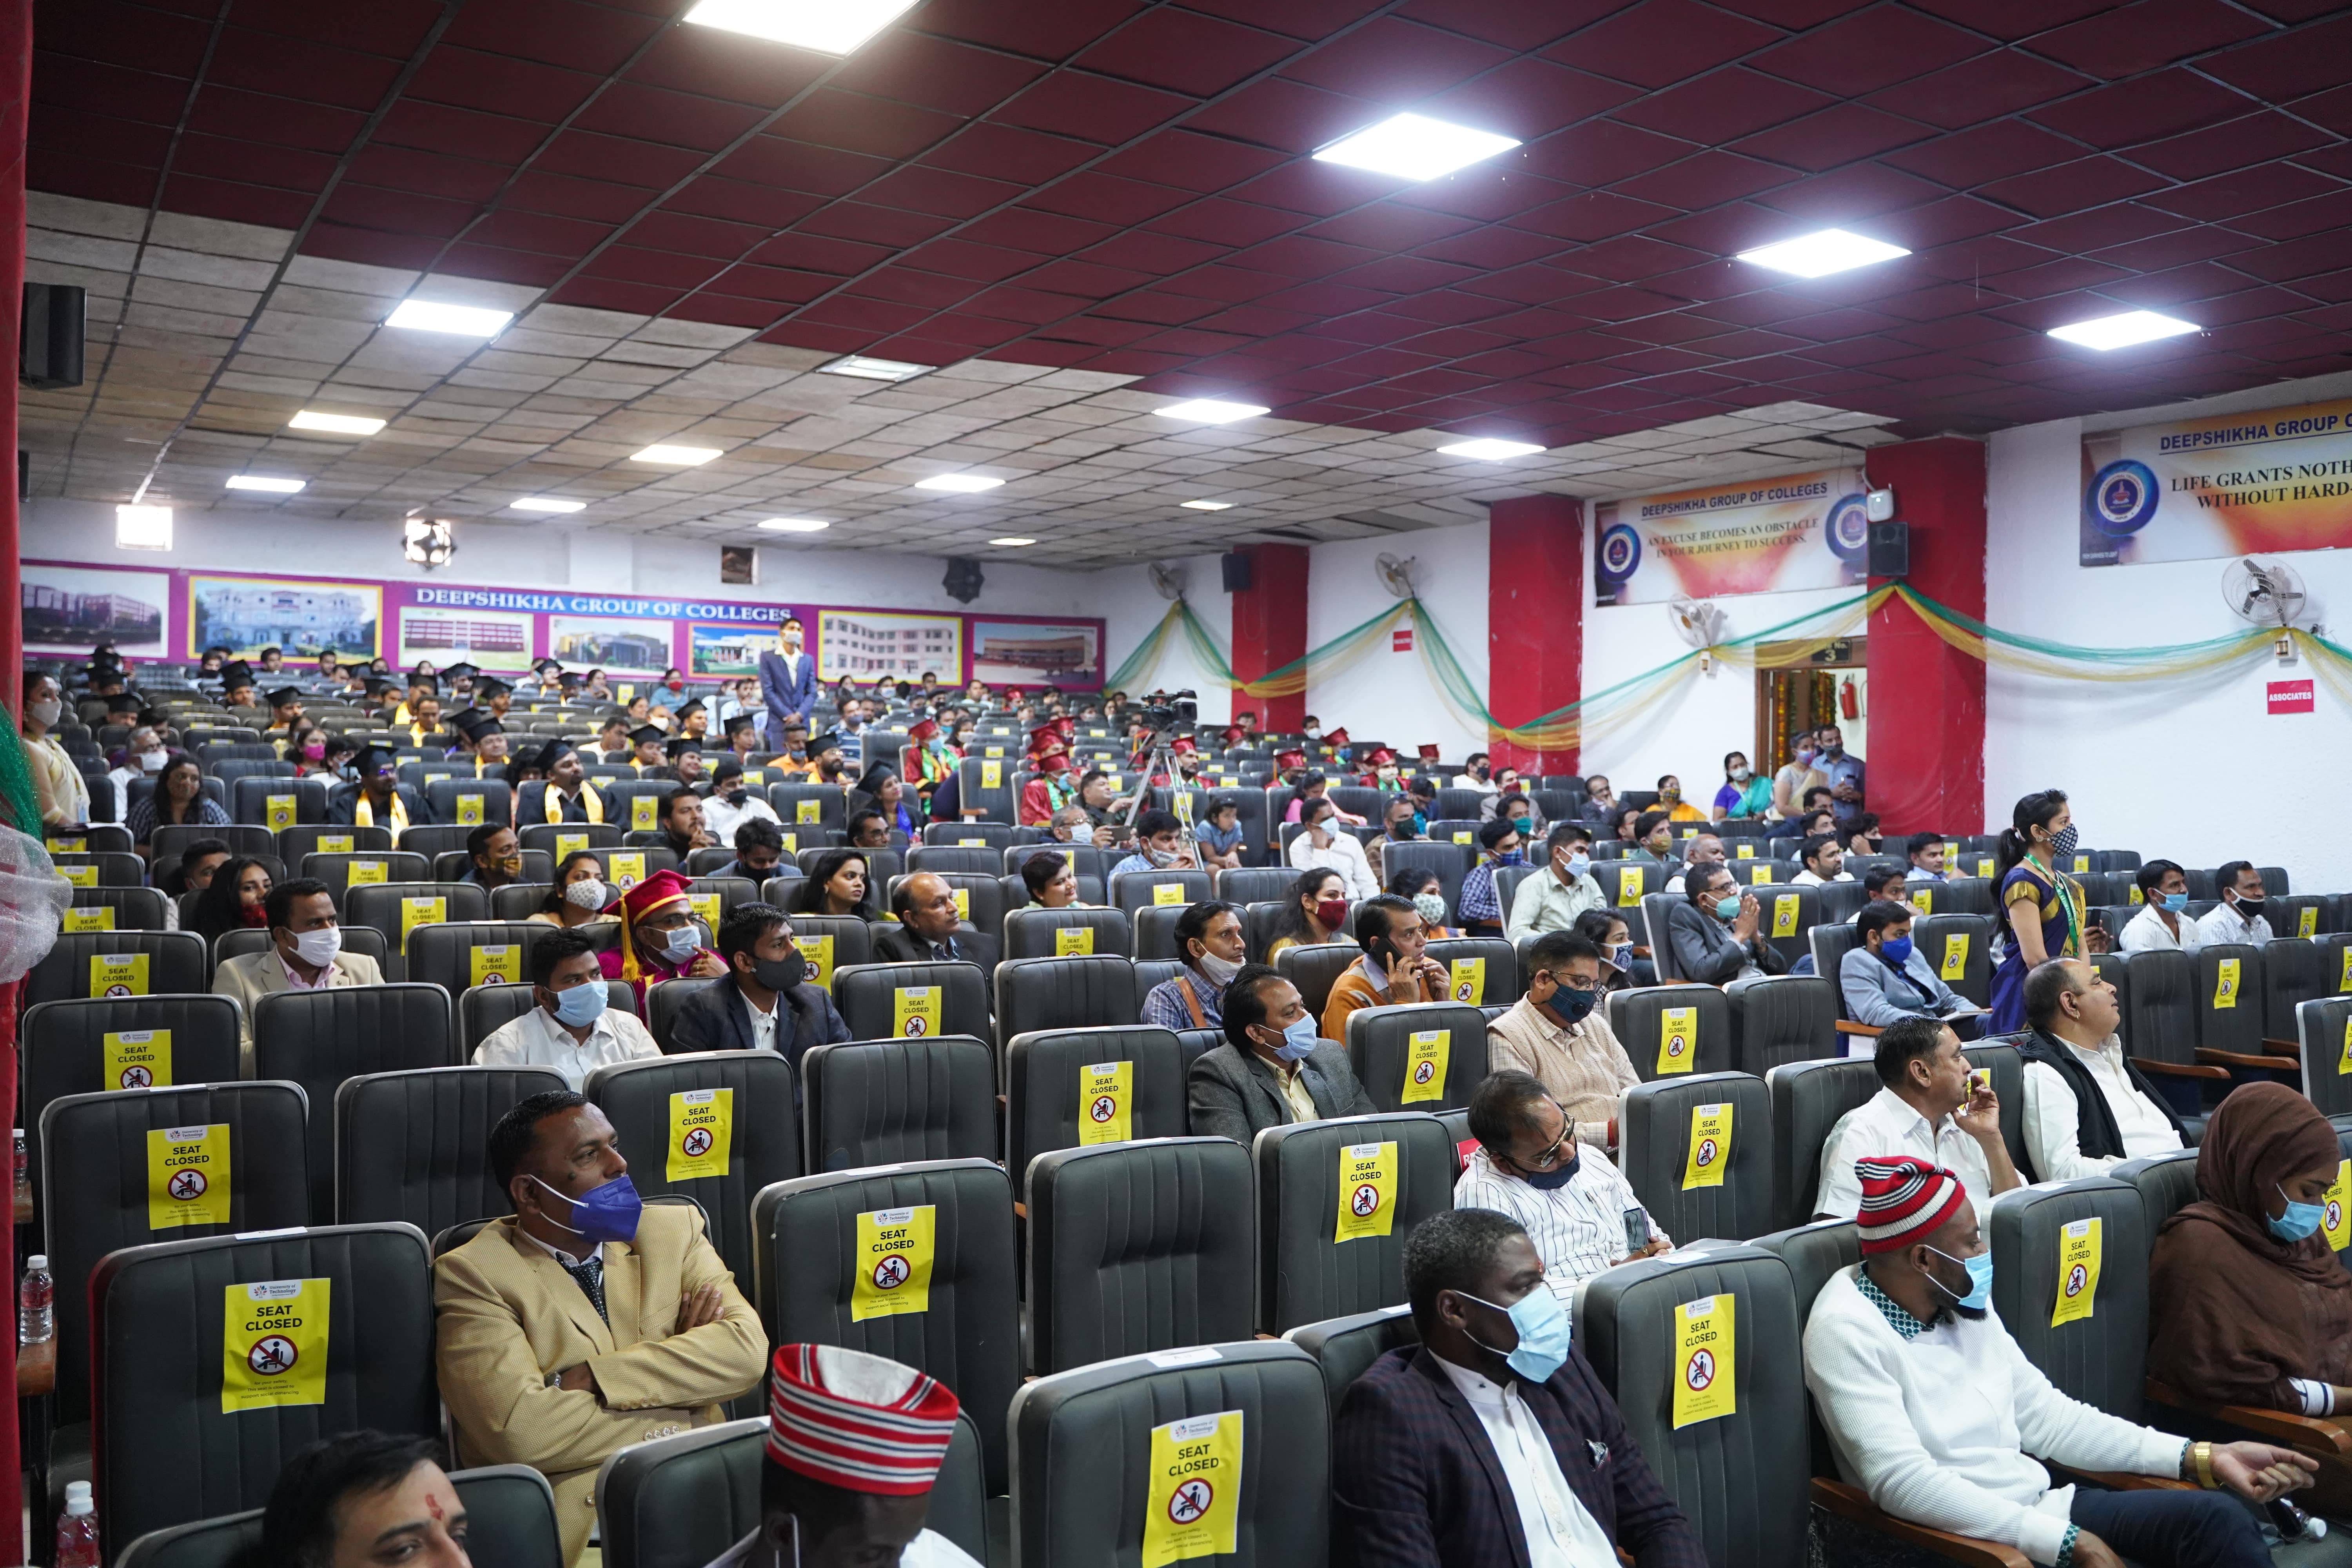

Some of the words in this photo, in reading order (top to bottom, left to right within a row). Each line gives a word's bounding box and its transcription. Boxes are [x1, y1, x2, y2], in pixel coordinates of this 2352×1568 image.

[2160, 424, 2269, 451] DEEPSHIKHA
[2274, 415, 2338, 437] GROUP
[2172, 475, 2211, 492] LIFE
[2217, 466, 2292, 487] GRANTS
[1642, 499, 1706, 517] DEEPSHIKHA
[1710, 493, 1746, 508] GROUP
[1750, 491, 1764, 502] OF
[1768, 482, 1828, 500] COLLEGES
[2197, 488, 2288, 509] WITHOUT
[1648, 538, 1661, 546] AN
[1662, 532, 1697, 545] EXCUSE
[1700, 526, 1746, 541] BECOMES
[1750, 524, 1762, 534] AN
[1765, 518, 1818, 534] OBSTACLE
[1657, 549, 1665, 559] IN
[1666, 545, 1694, 557] YOUR
[1696, 540, 1742, 554] JOURNEY
[1744, 539, 1757, 549] TO
[417, 588, 566, 612] DEEPSHIKHA
[570, 599, 650, 617] GROUP
[653, 601, 682, 617] OF
[685, 604, 792, 622] COLLEGES
[1825, 649, 1837, 662] 3
[2269, 691, 2312, 702] ASSOCIATES
[1091, 1085, 1118, 1094] CLOSED
[682, 1116, 716, 1125] CLOSED
[173, 1145, 201, 1154] SEAT
[165, 1155, 209, 1166] CLOSED
[1356, 1162, 1376, 1171] SEAT
[1350, 1172, 1381, 1181] CLOSED
[880, 1229, 907, 1240] SEAT
[873, 1240, 914, 1252] CLOSED
[2071, 1241, 2085, 1250] SEAT
[2067, 1250, 2090, 1262] CLOSED
[257, 1305, 292, 1317] SEAT
[245, 1318, 302, 1331] CLOSED
[1691, 1320, 1710, 1333] SEAT
[1686, 1331, 1717, 1347] CLOSED
[1178, 1444, 1210, 1459] SEAT
[1169, 1457, 1219, 1476] CLOSED
